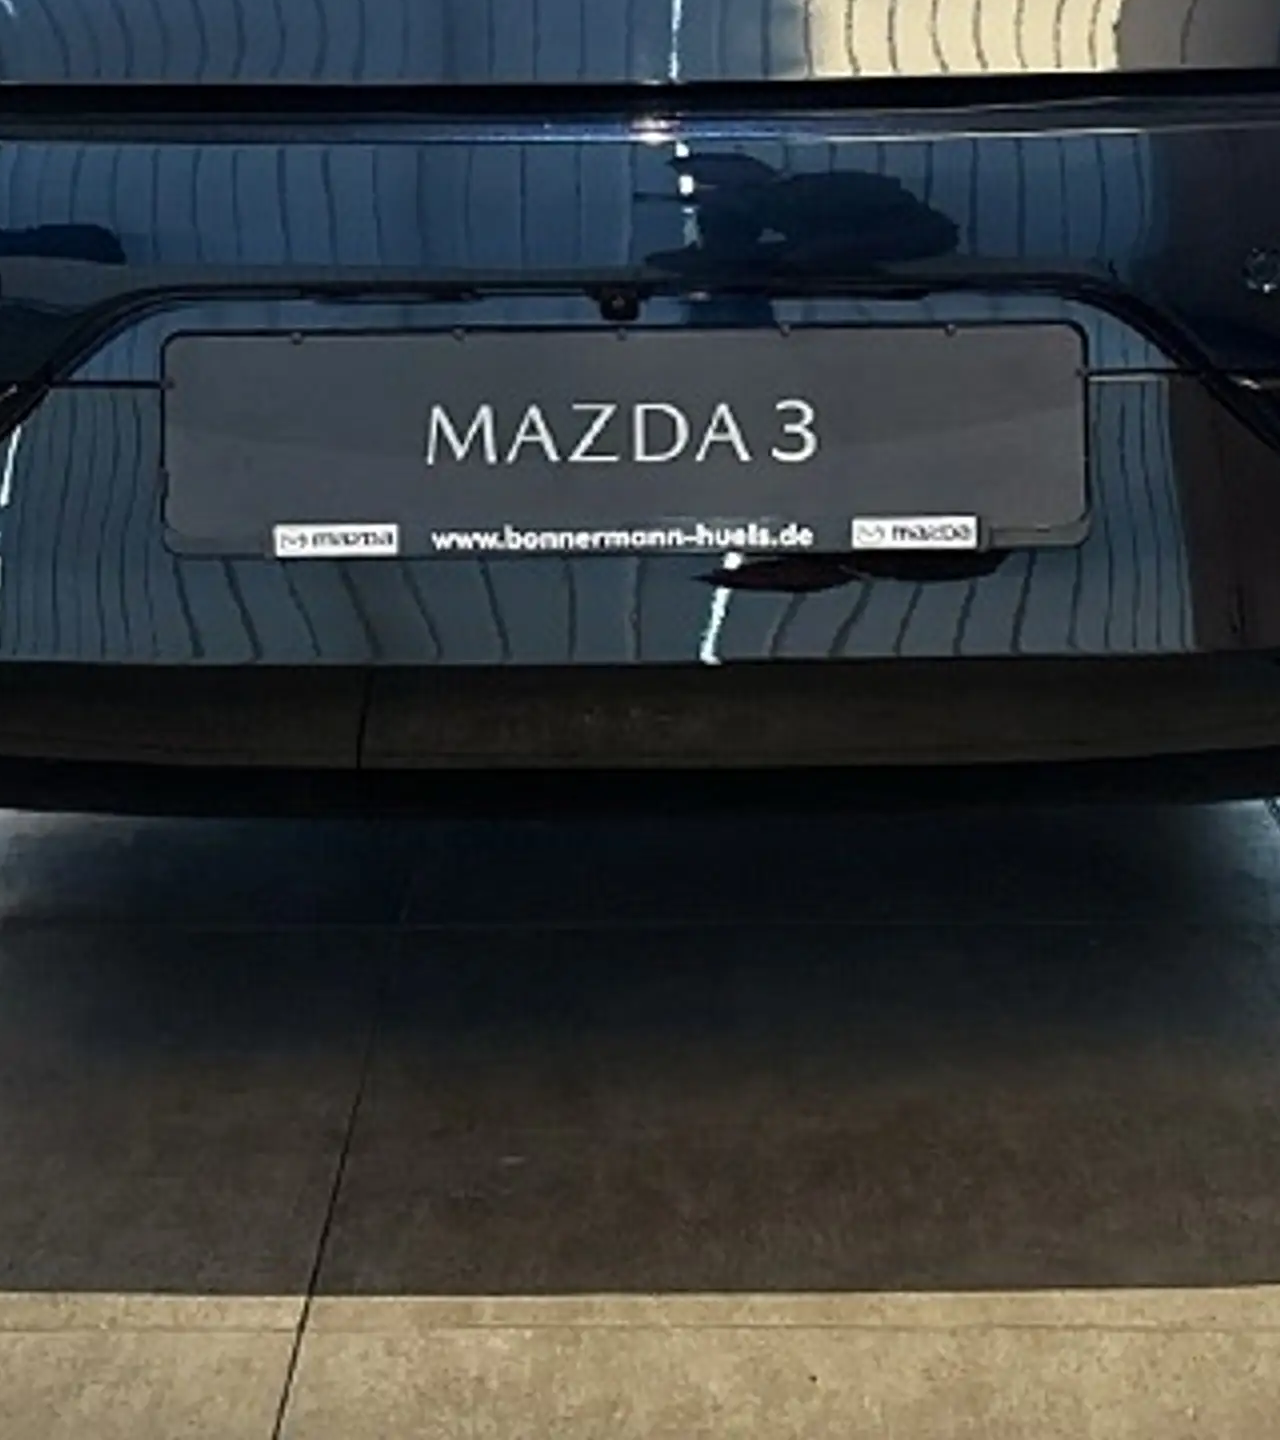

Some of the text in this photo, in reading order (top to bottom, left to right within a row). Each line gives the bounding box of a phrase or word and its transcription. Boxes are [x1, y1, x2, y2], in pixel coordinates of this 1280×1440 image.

[426, 398, 818, 465] MAZDA 3
[431, 523, 814, 551] www.bonnermann-huels.de
